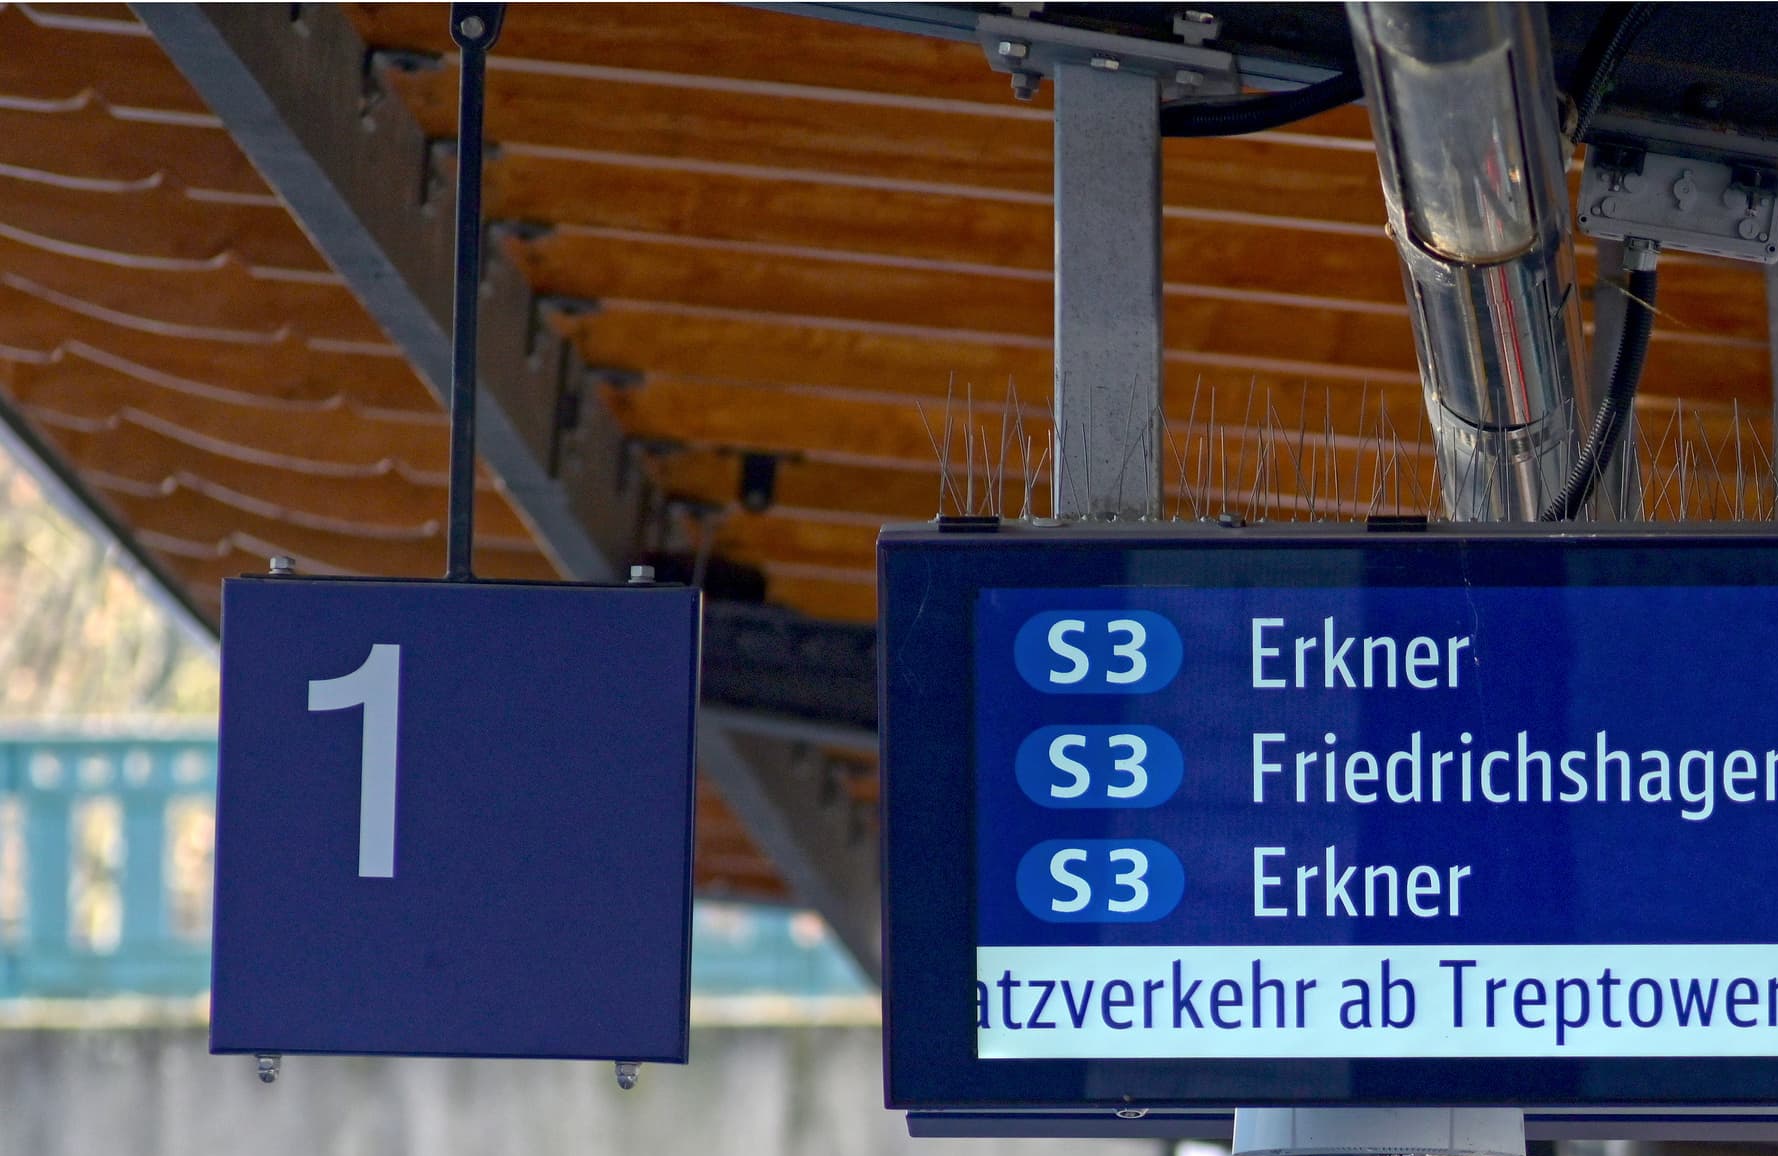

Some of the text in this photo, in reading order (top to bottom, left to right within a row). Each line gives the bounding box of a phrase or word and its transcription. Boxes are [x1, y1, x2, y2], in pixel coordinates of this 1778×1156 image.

[1252, 615, 1470, 689] Erkner
[308, 643, 401, 878] 1
[1254, 844, 1471, 918] Erkner
[1339, 958, 1416, 1030] ab
